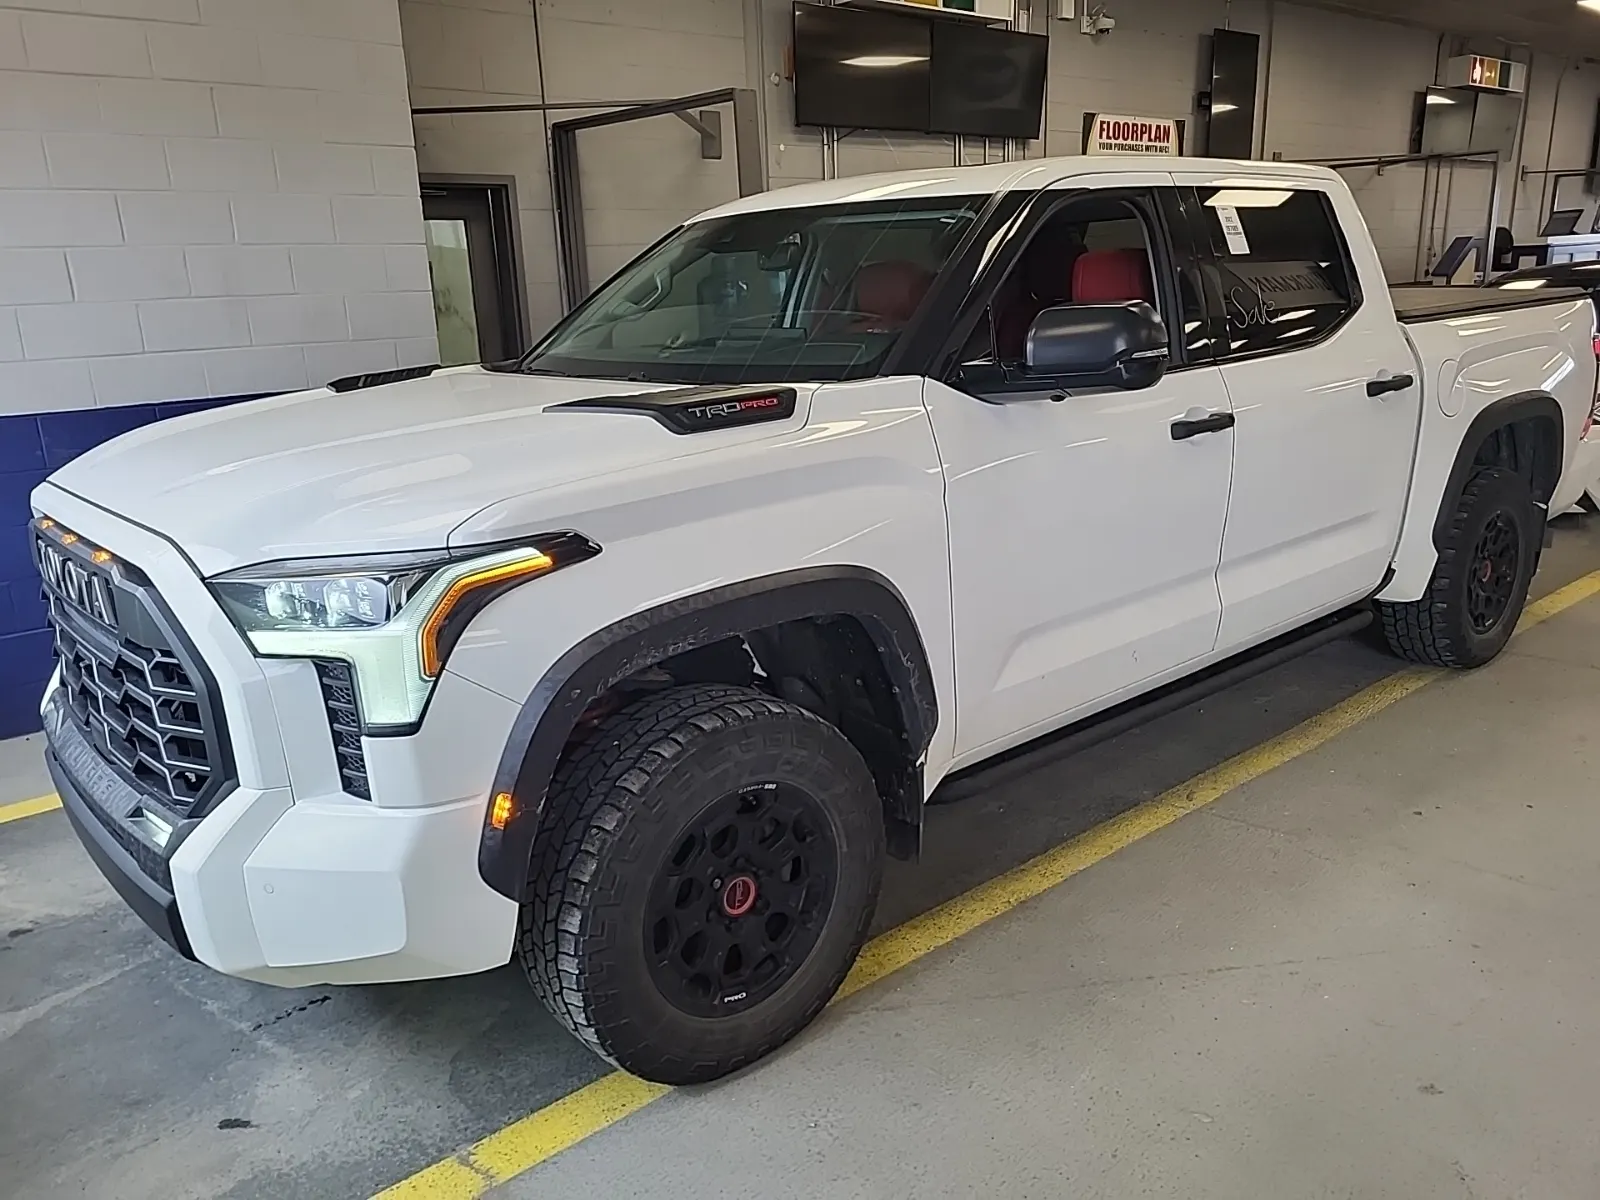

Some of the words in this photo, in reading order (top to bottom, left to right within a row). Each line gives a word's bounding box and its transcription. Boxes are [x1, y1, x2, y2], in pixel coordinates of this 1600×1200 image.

[1098, 120, 1171, 144] FLOORPLAN
[1098, 142, 1113, 151] YOUR
[1113, 143, 1144, 152] PURCHASES
[1144, 144, 1158, 153] WITH
[1230, 286, 1280, 329] Sale
[687, 402, 740, 419] TRD
[740, 398, 778, 410] PRO
[37, 539, 118, 629] TOYOTA
[724, 991, 747, 1003] PRO
